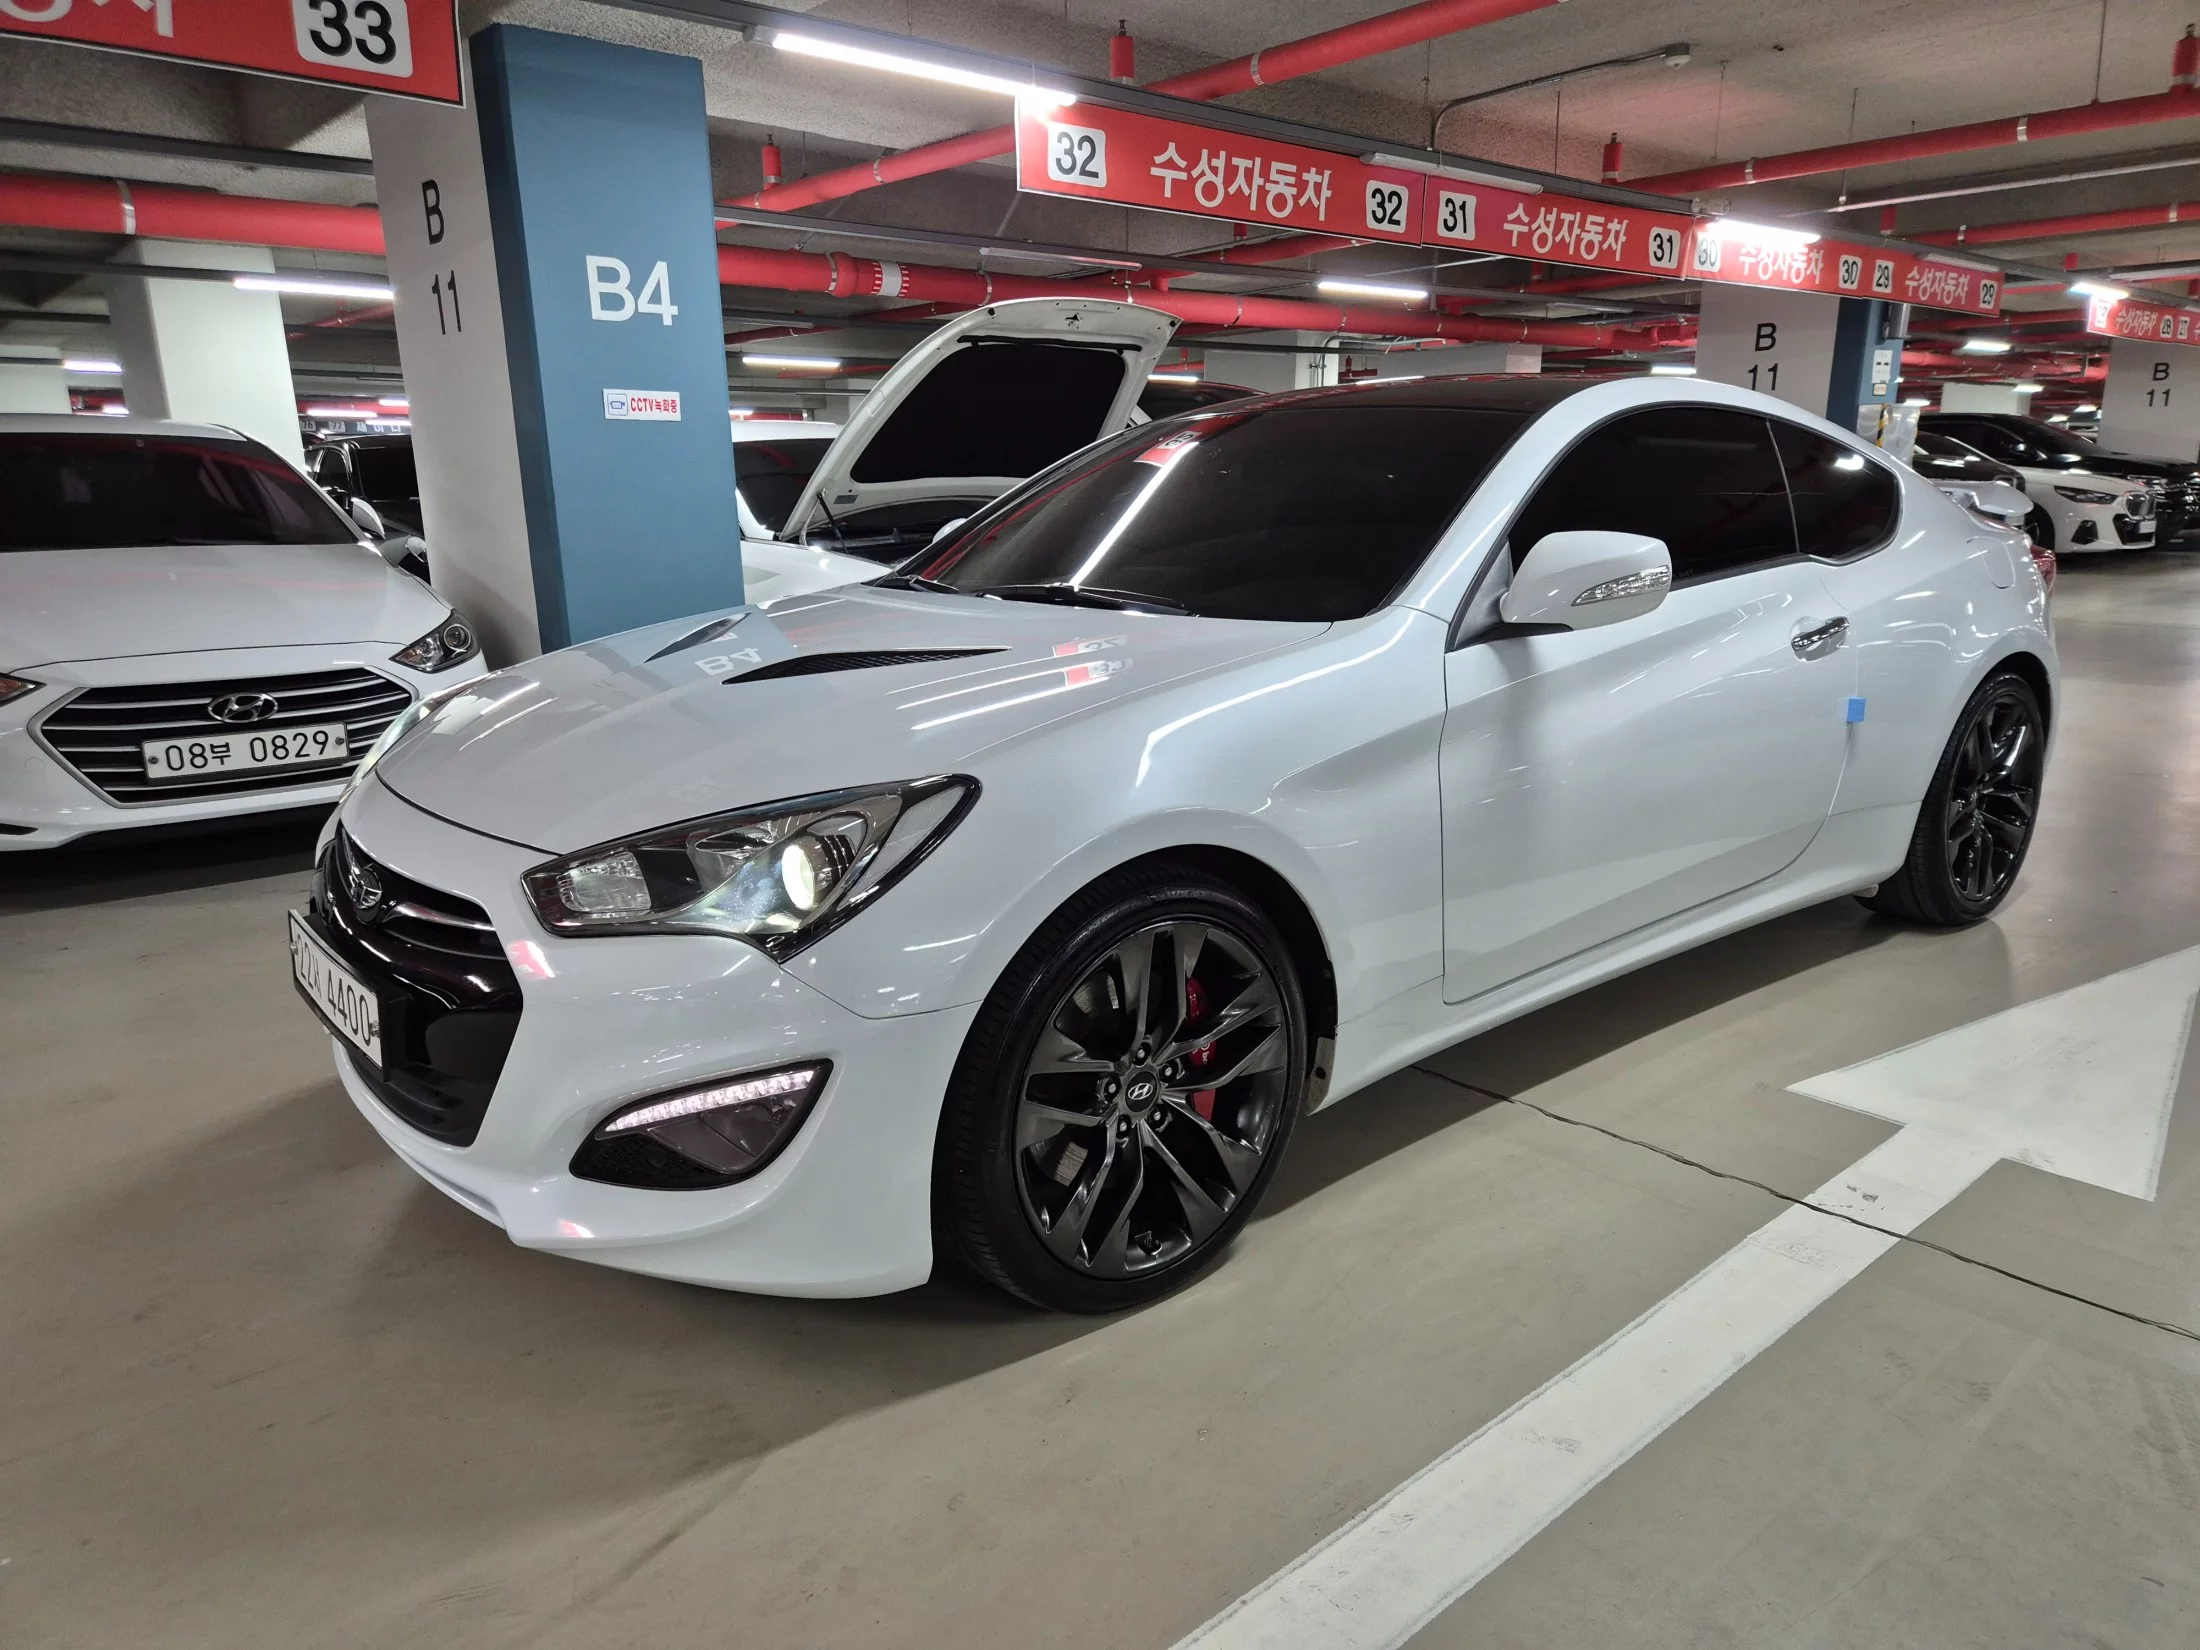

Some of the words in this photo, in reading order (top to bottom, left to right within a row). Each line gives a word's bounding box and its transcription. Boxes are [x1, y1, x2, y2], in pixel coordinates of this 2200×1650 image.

[308, 0, 398, 65] 33
[1054, 131, 1100, 180] 32
[1150, 142, 1333, 222] 수성자동차
[1370, 188, 1403, 227] 32
[422, 179, 445, 245] B
[1443, 197, 1468, 235] 31
[1503, 203, 1629, 262] 수성자동차
[1653, 232, 1674, 264] 31
[586, 254, 680, 327] B4
[1697, 236, 1719, 268] 30
[1738, 244, 1824, 285] 수성자동차
[1841, 258, 1859, 287] 30
[1875, 263, 1891, 290] 29
[1904, 265, 1972, 305] 수성자동차
[1981, 283, 1996, 306] 29
[431, 269, 462, 335] 11
[1754, 322, 1778, 352] B
[1747, 362, 1780, 392] 11
[2145, 387, 2171, 408] 11
[2152, 362, 2171, 382] B
[165, 741, 232, 772] 08부
[249, 729, 330, 763] 0829
[327, 967, 372, 1047] 4400
